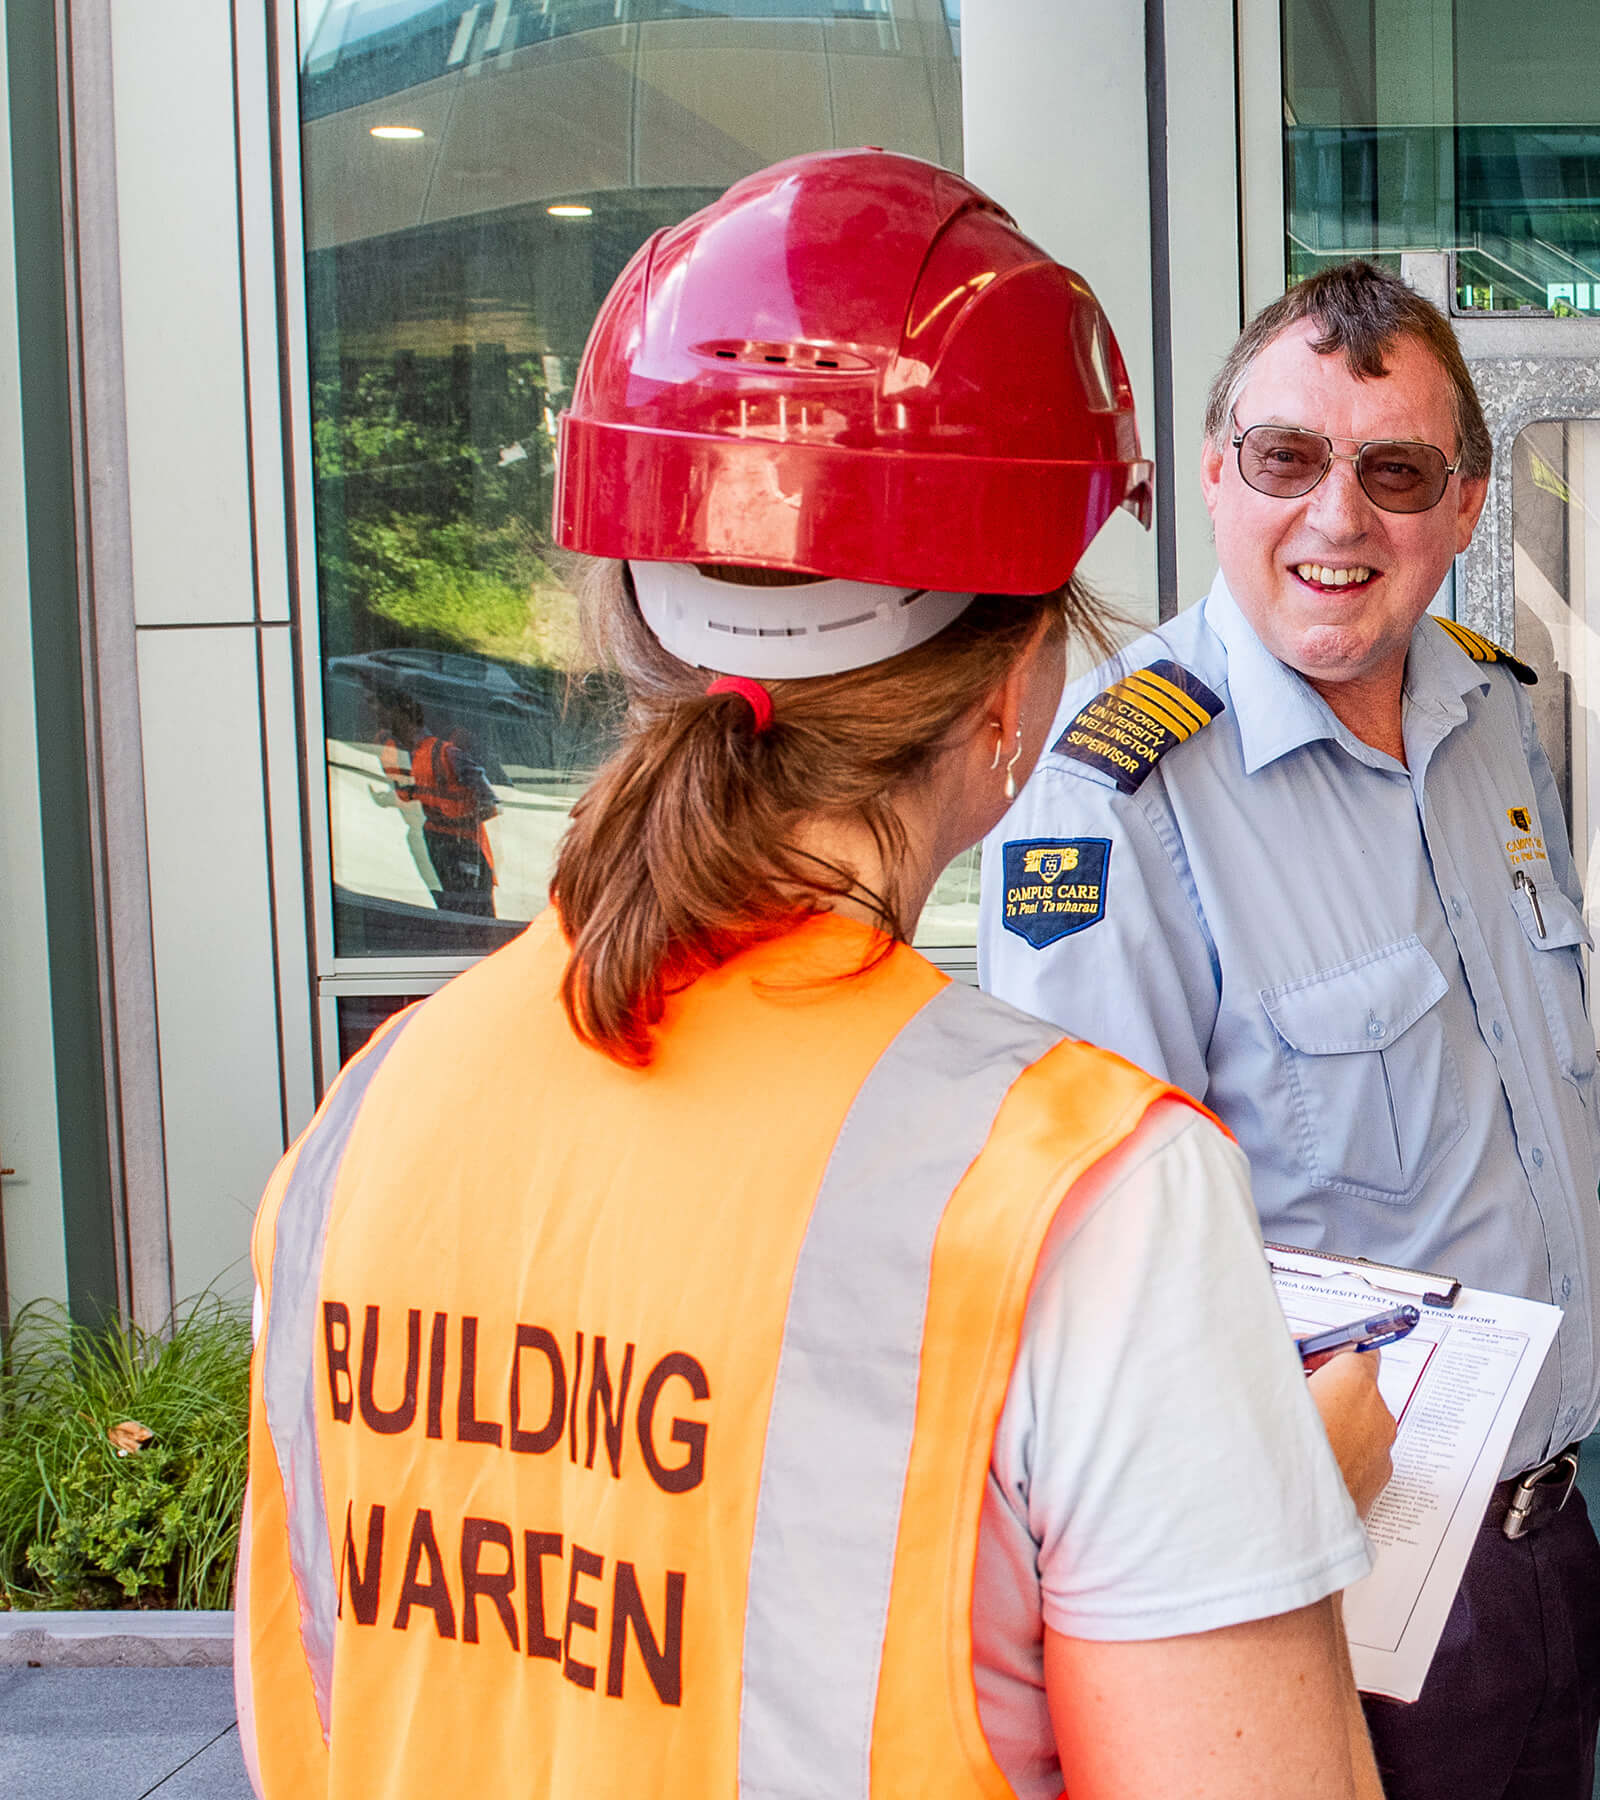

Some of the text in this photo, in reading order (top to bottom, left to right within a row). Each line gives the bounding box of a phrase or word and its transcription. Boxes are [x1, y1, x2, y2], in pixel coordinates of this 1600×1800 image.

[1075, 713, 1159, 763] WELLINGTON
[1088, 704, 1165, 747] UNIVERSITY
[1107, 697, 1166, 738] VICTORIA
[1067, 731, 1139, 774] SUPERVISOR
[1008, 885, 1099, 902] CAMPUS CARE
[1042, 900, 1098, 914] Tawharau
[1301, 1285, 1359, 1298] UNIVERSITY
[1361, 1295, 1389, 1304] POST
[1457, 1315, 1497, 1325] REPORT
[323, 1301, 711, 1495] BUILDING
